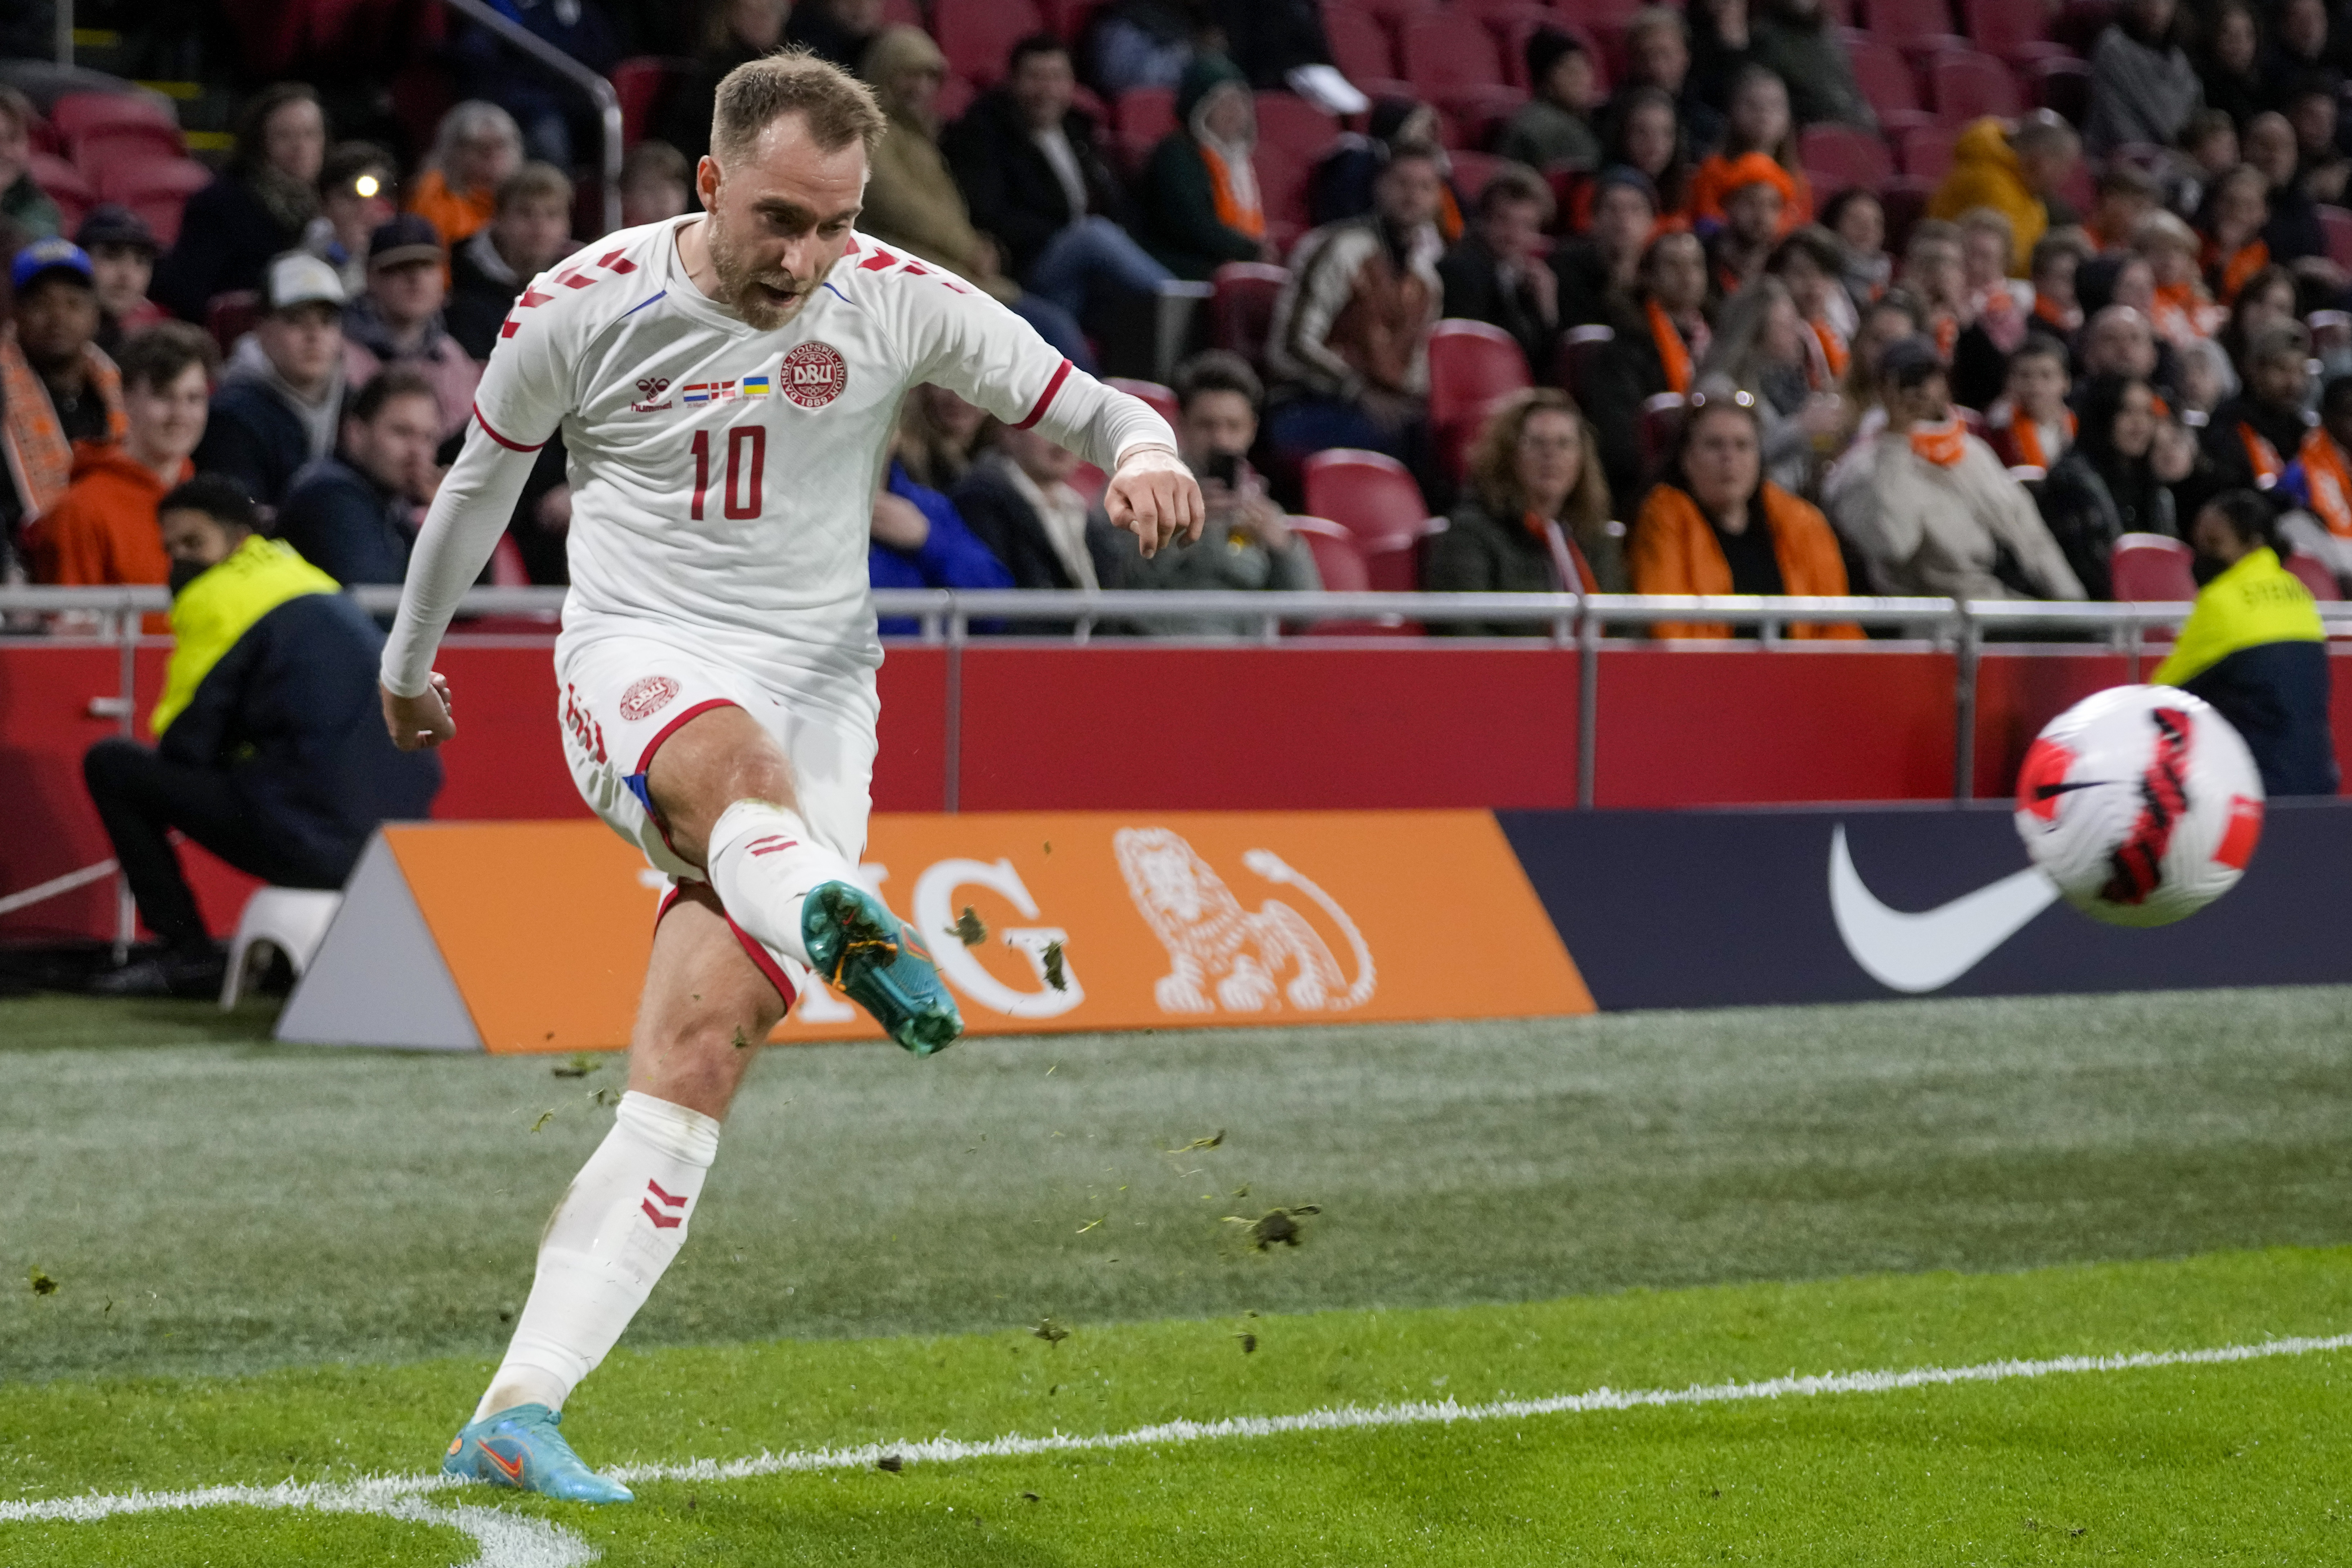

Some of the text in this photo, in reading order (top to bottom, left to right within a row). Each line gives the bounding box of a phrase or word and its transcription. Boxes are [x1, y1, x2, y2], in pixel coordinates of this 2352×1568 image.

[782, 362, 798, 400] DANSK
[801, 397, 828, 407] 1889
[793, 364, 833, 385] DBU
[690, 425, 765, 521] 10
[629, 682, 667, 711] DBU
